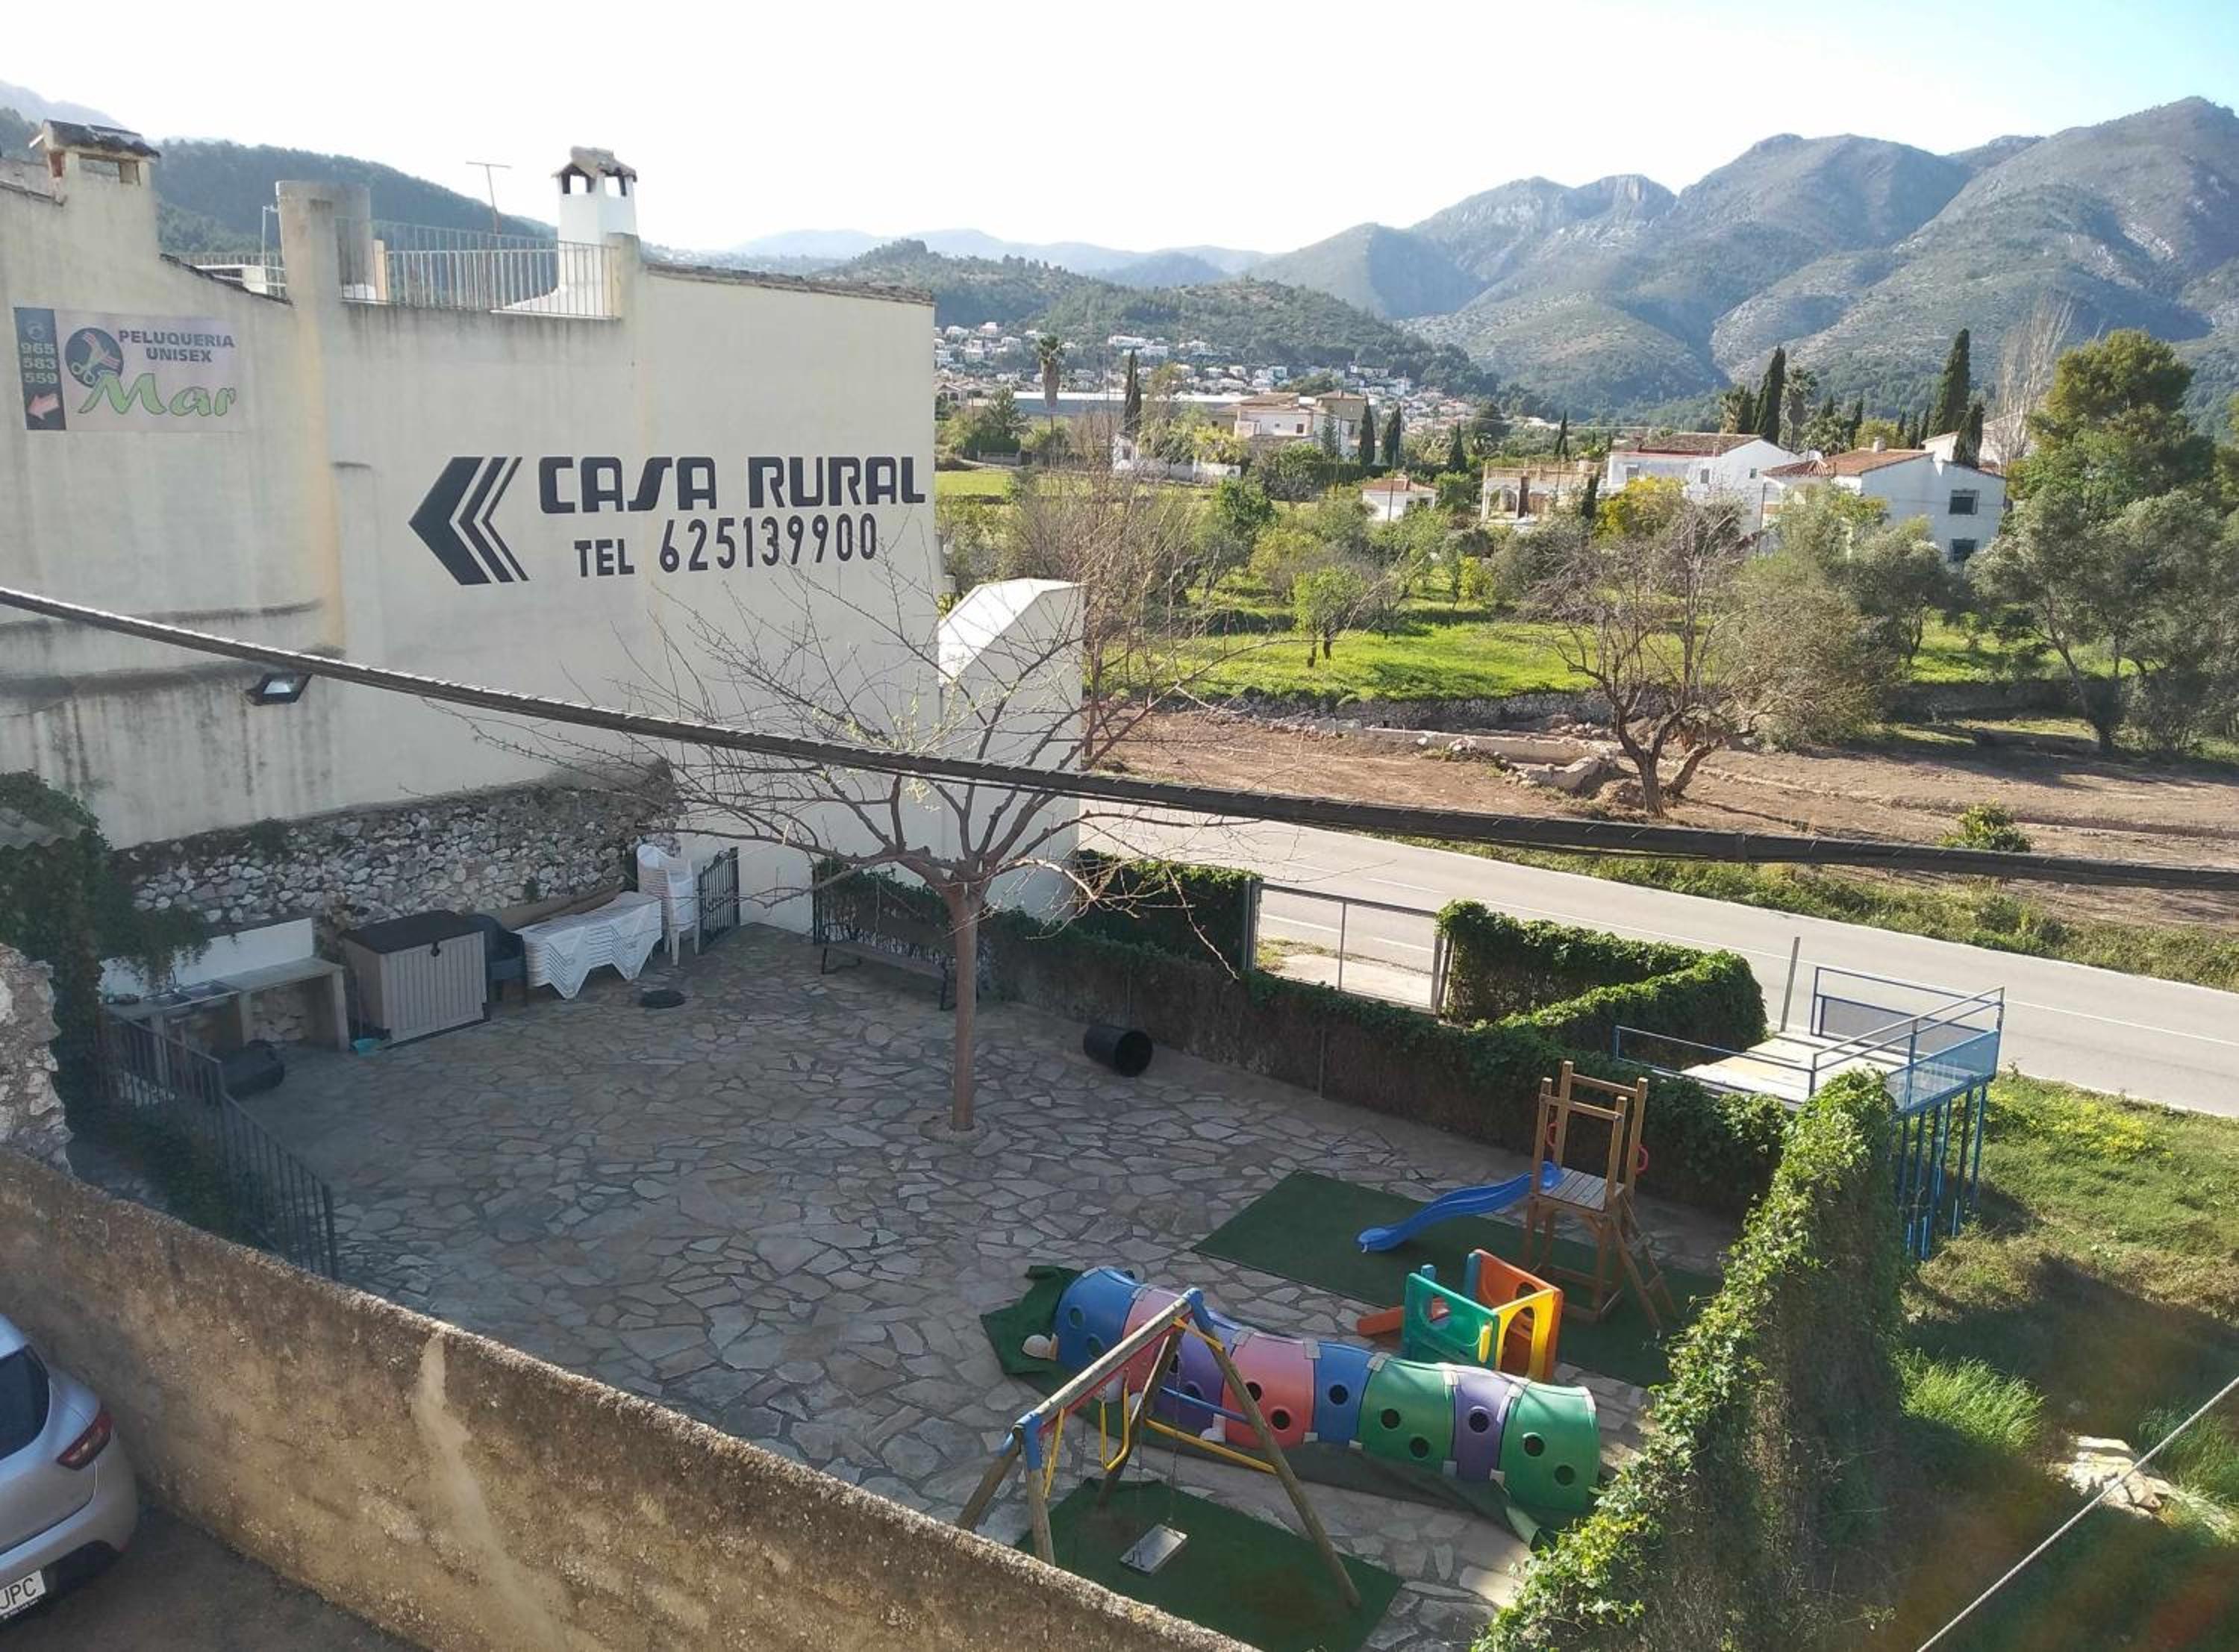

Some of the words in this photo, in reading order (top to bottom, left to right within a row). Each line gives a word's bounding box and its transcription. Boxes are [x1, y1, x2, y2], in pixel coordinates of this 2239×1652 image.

[119, 329, 235, 348] PELUQUERIA
[21, 342, 54, 355] 965
[146, 347, 212, 363] UNISEX
[23, 357, 56, 370] 583
[25, 372, 57, 384] 559
[78, 372, 237, 416] Mar
[539, 457, 718, 513] CASA
[749, 457, 926, 508] RURAL
[574, 539, 634, 577] TEL
[659, 513, 877, 574] 625139900
